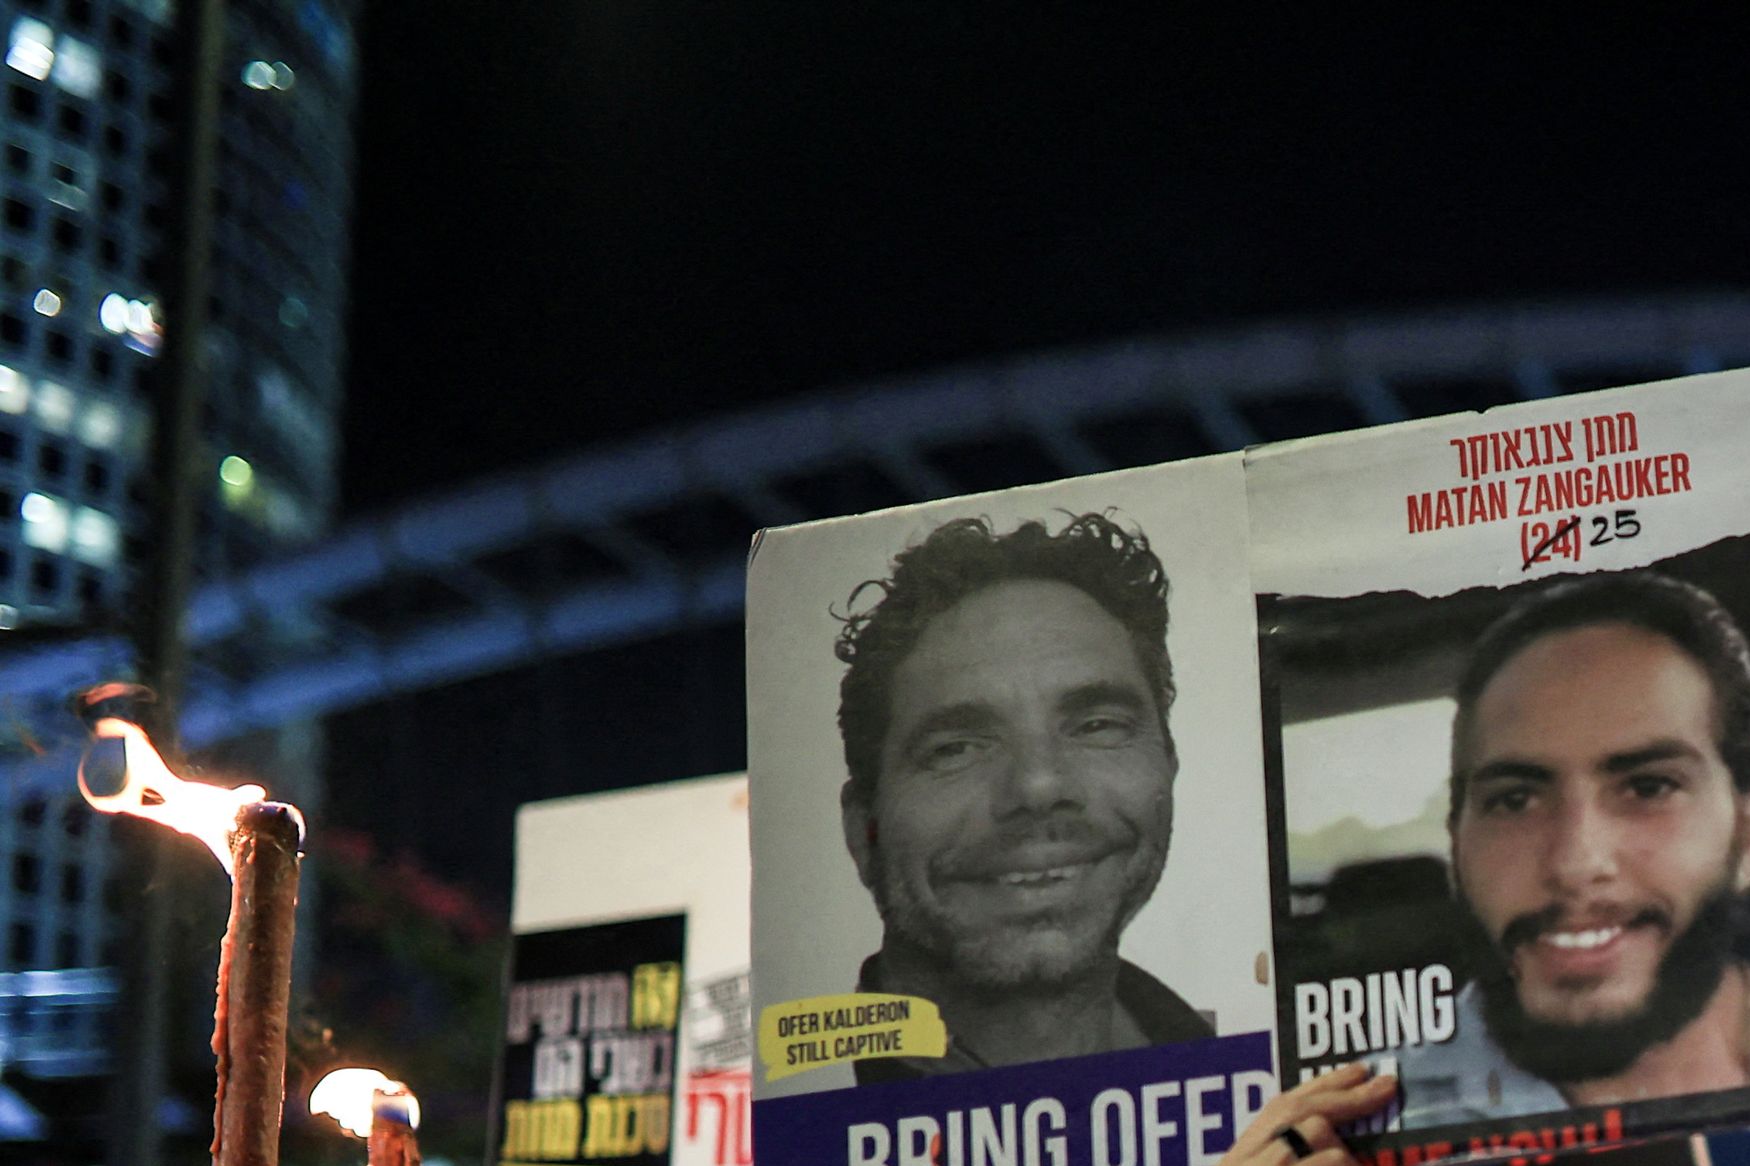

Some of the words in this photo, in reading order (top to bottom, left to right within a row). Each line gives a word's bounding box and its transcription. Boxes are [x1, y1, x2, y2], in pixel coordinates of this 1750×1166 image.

[1449, 420, 1575, 481] צנגאוקר
[1582, 411, 1638, 463] מתן
[1407, 480, 1507, 534] MATAN
[1515, 452, 1693, 517] ZANGAUKER
[1590, 509, 1641, 546] 25
[779, 1012, 819, 1037] OFER
[824, 1001, 910, 1031] KALDERON
[1295, 965, 1455, 1059] BRING
[786, 1039, 830, 1065] STILL
[835, 1029, 902, 1058] CAPTIVE
